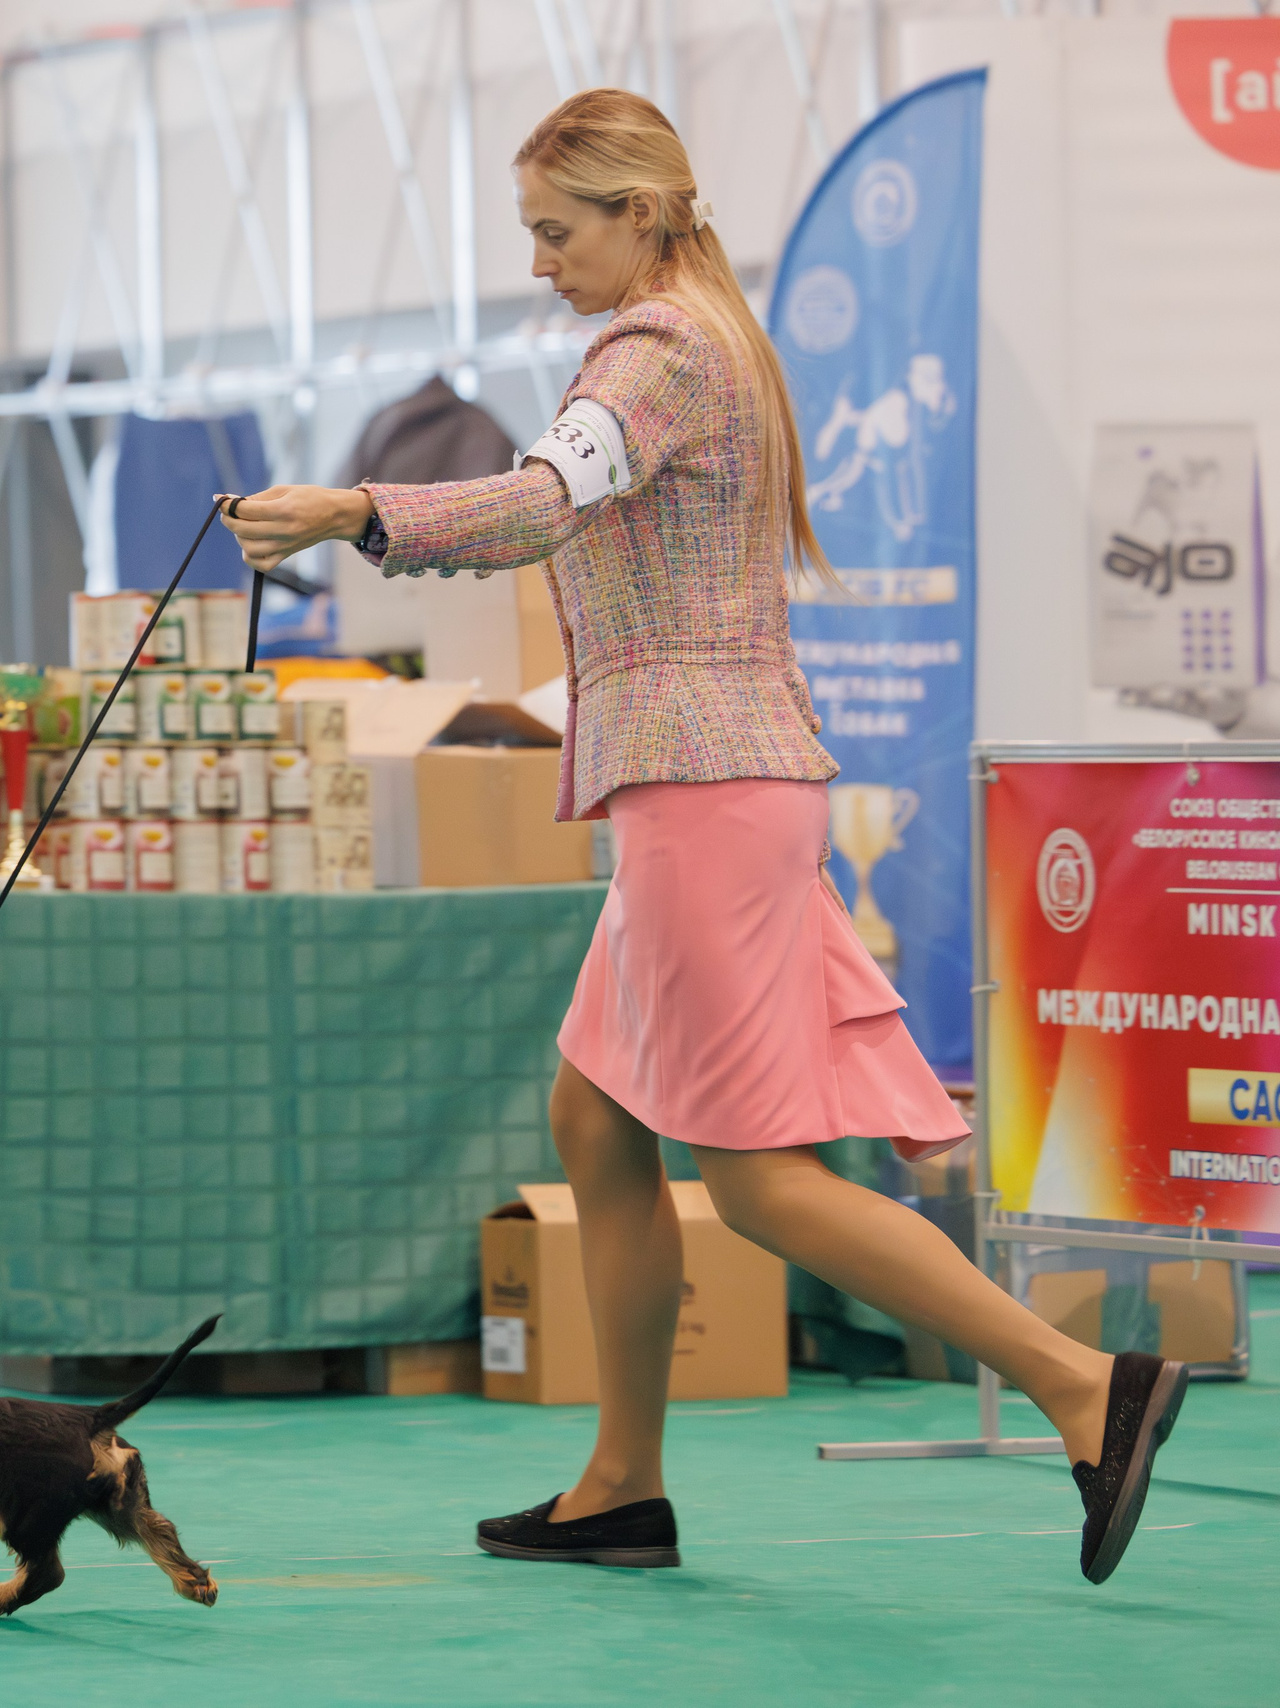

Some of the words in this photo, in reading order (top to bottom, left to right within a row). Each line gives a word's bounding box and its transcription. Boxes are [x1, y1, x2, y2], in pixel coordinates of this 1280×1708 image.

[1170, 798, 1215, 818] СОЮЗ
[1186, 859, 1276, 881] BELORUSSIAN
[1187, 902, 1277, 938] MINSK
[1230, 1078, 1280, 1121] CA
